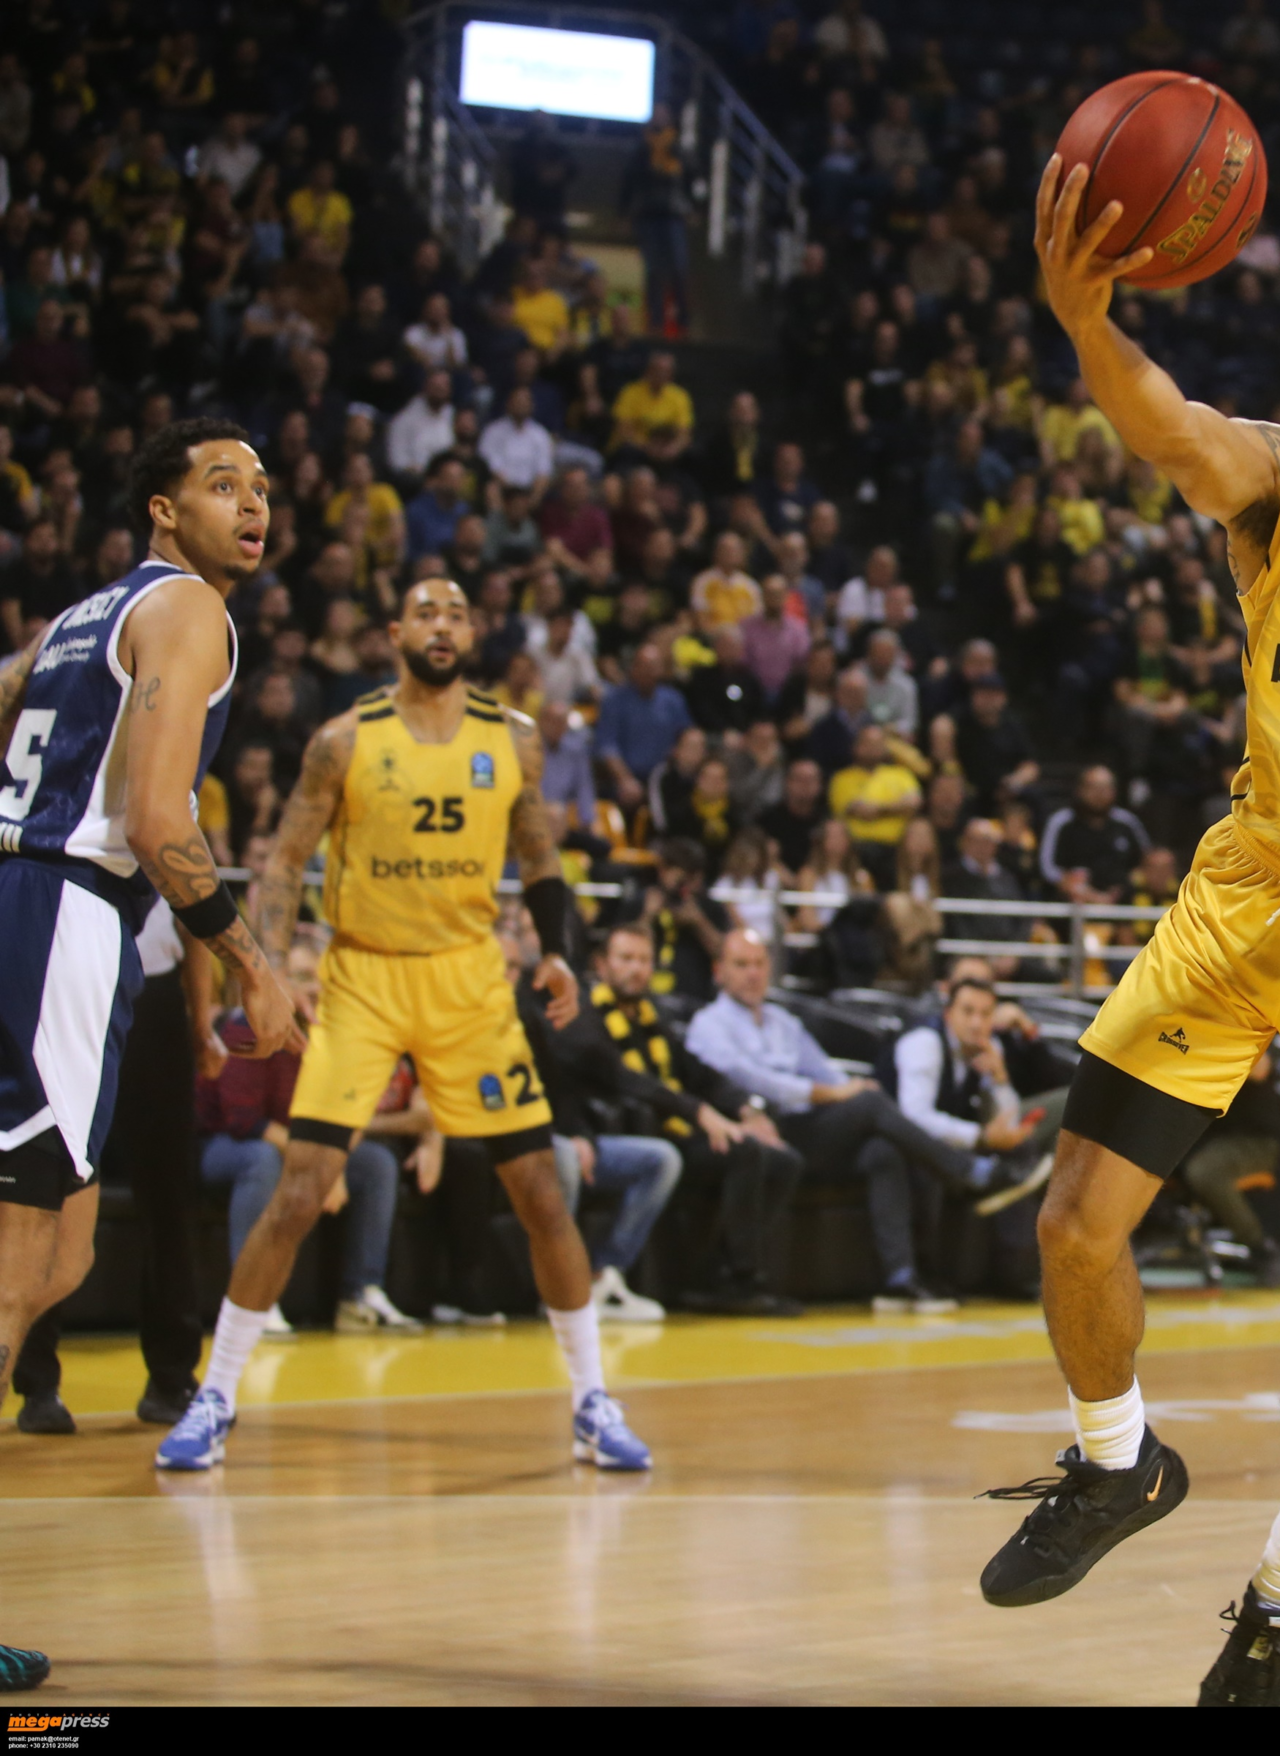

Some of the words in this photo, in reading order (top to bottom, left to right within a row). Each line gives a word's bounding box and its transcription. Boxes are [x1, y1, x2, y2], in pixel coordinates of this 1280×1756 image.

[0, 708, 58, 821] 5
[413, 796, 464, 834] 25
[371, 855, 484, 879] betsso
